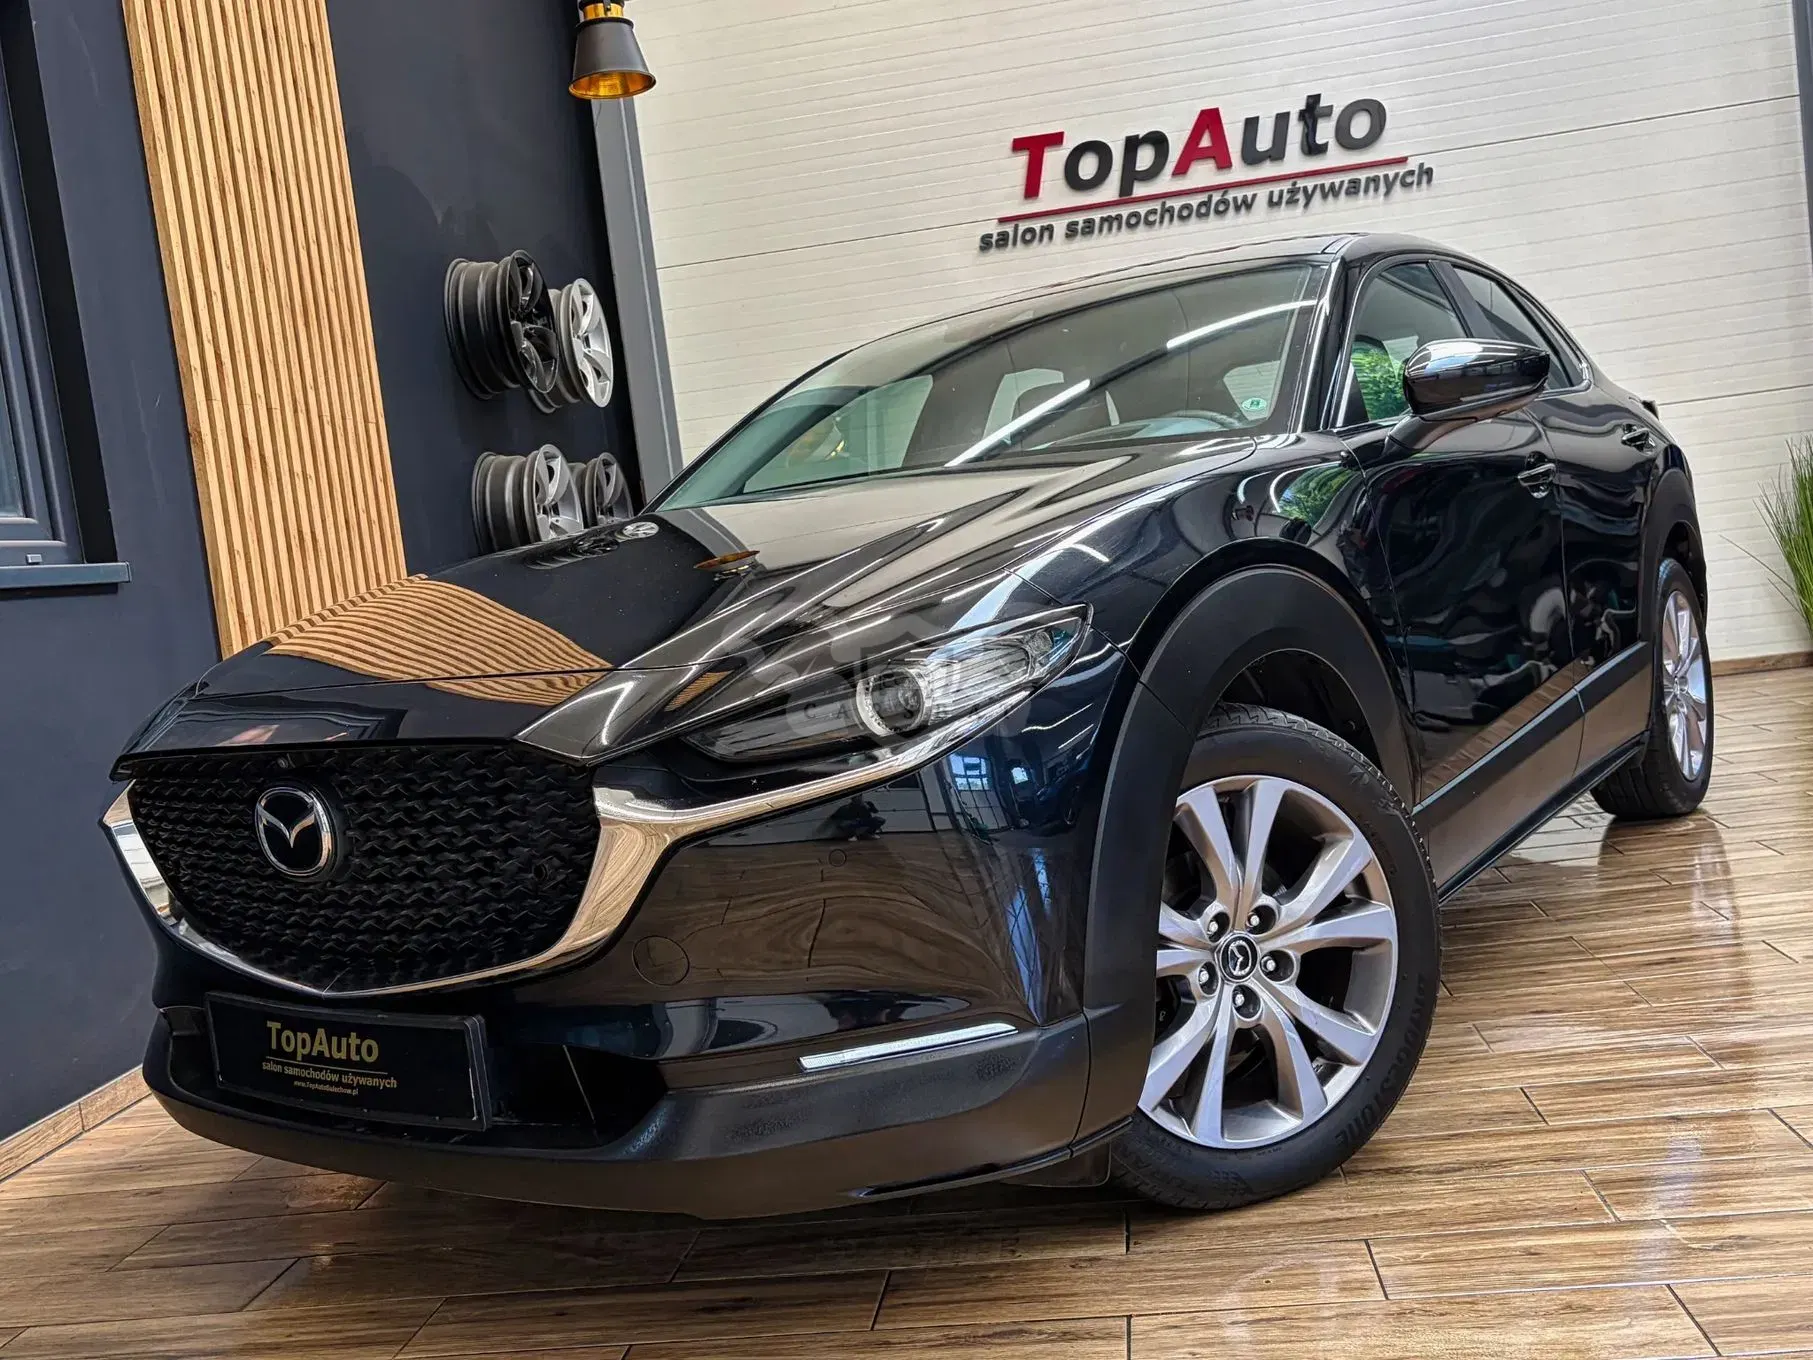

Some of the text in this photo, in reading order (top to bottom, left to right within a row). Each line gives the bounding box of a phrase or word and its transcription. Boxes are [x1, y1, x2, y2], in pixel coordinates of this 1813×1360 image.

[1011, 93, 1387, 201] TopAuto
[979, 163, 1434, 253] salon samochodów używanych
[266, 1020, 379, 1063] TopAuto
[262, 1061, 398, 1090] salon samochodów używanych
